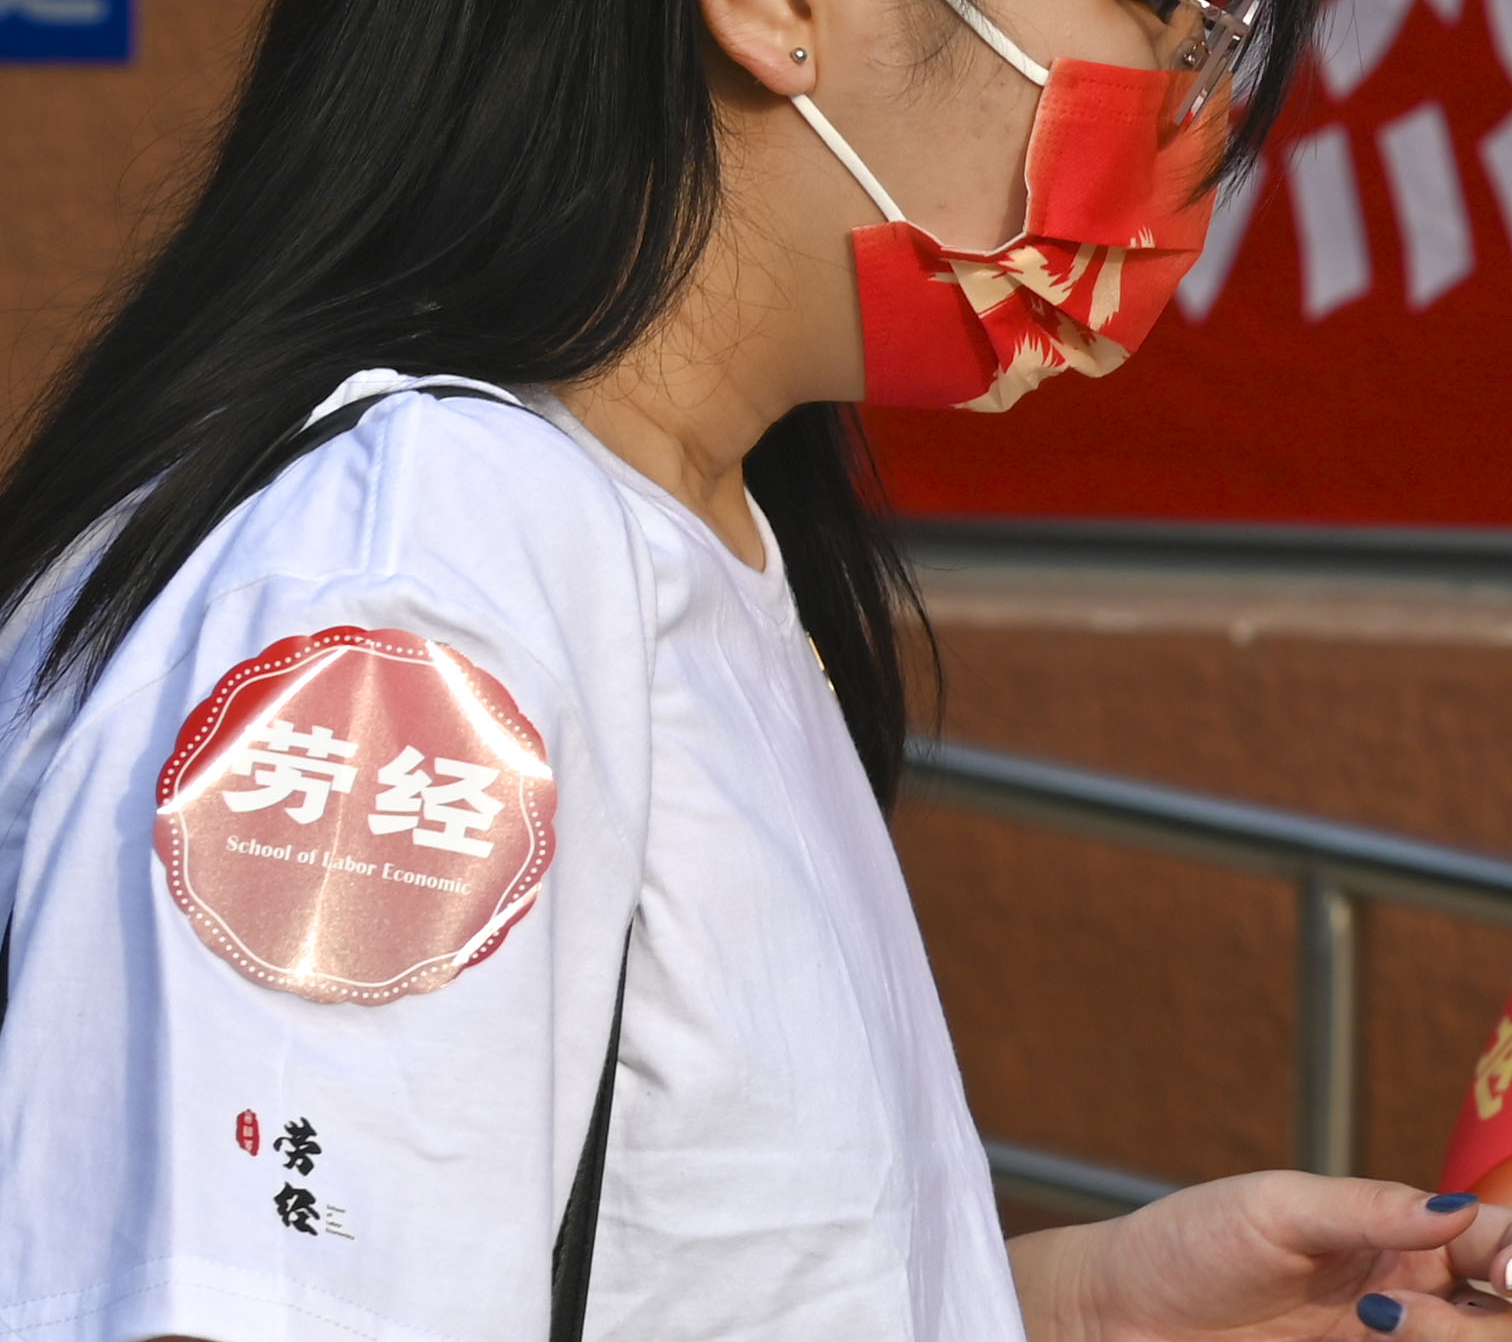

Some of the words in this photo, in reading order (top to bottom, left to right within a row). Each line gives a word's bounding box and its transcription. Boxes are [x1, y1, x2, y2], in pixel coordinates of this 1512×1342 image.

[221, 720, 506, 859] 劳经
[226, 835, 293, 862] School
[297, 848, 319, 866] of
[325, 856, 378, 877] Labor
[382, 862, 473, 895] Economic
[273, 1116, 322, 1236] 劳经
